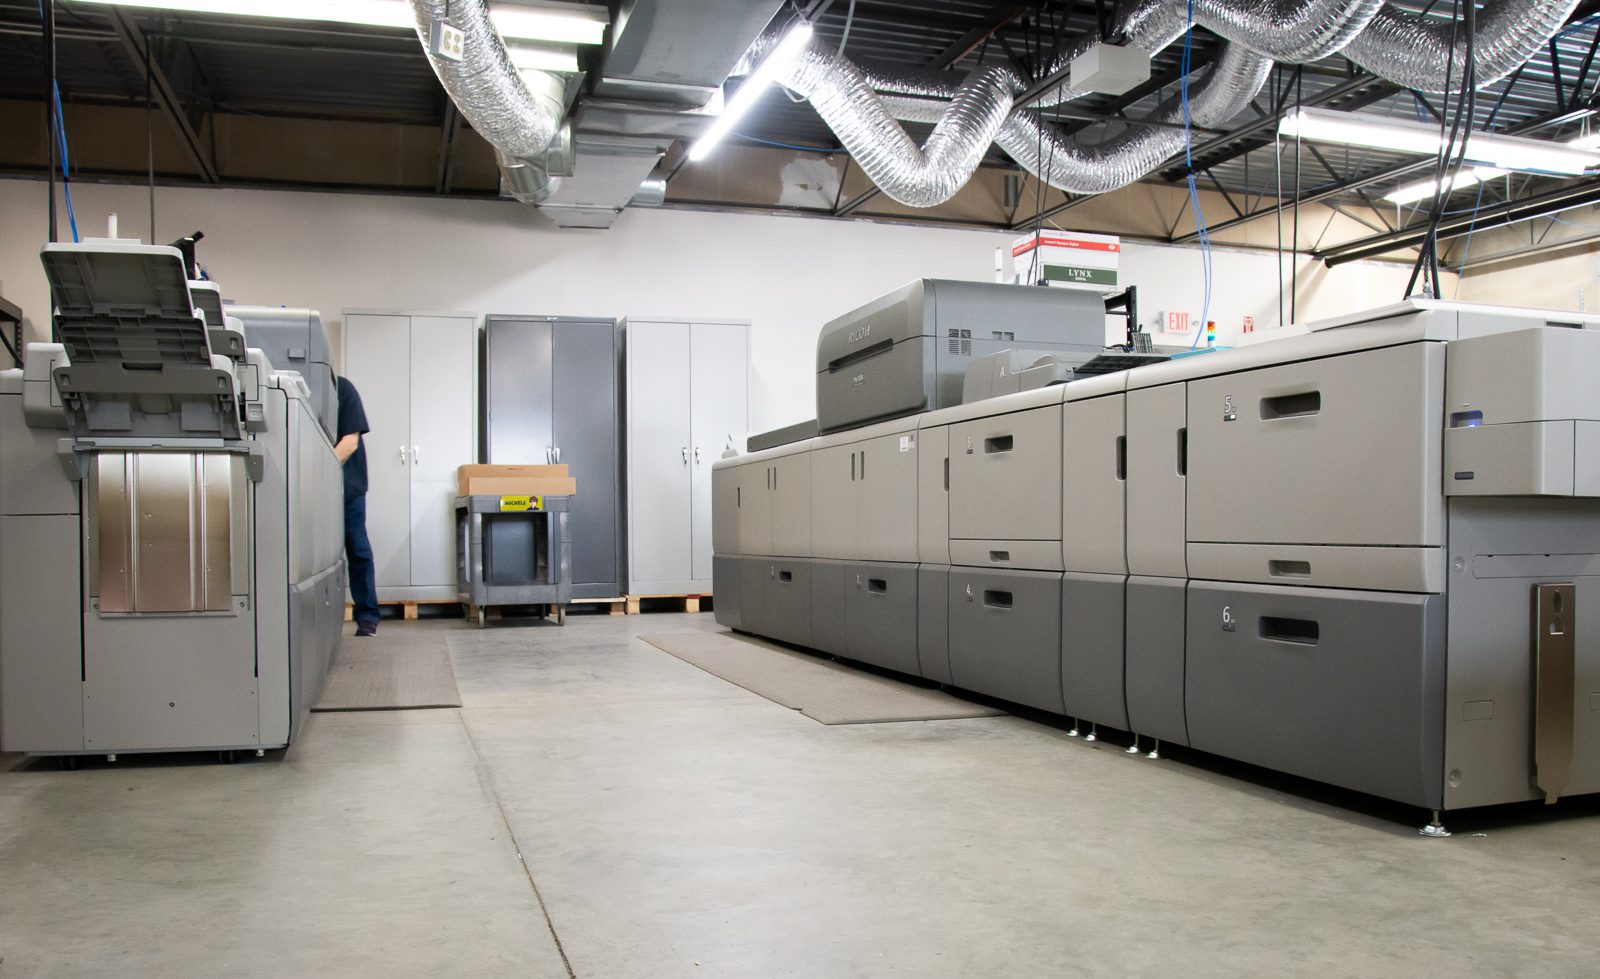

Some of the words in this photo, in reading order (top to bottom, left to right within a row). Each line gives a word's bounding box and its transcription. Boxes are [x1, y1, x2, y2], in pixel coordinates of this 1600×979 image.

[1068, 268, 1092, 278] LYNX
[1169, 312, 1189, 331] EXIT
[848, 324, 870, 344] RICOH
[1224, 395, 1231, 414] 5
[1222, 606, 1231, 623] 6
